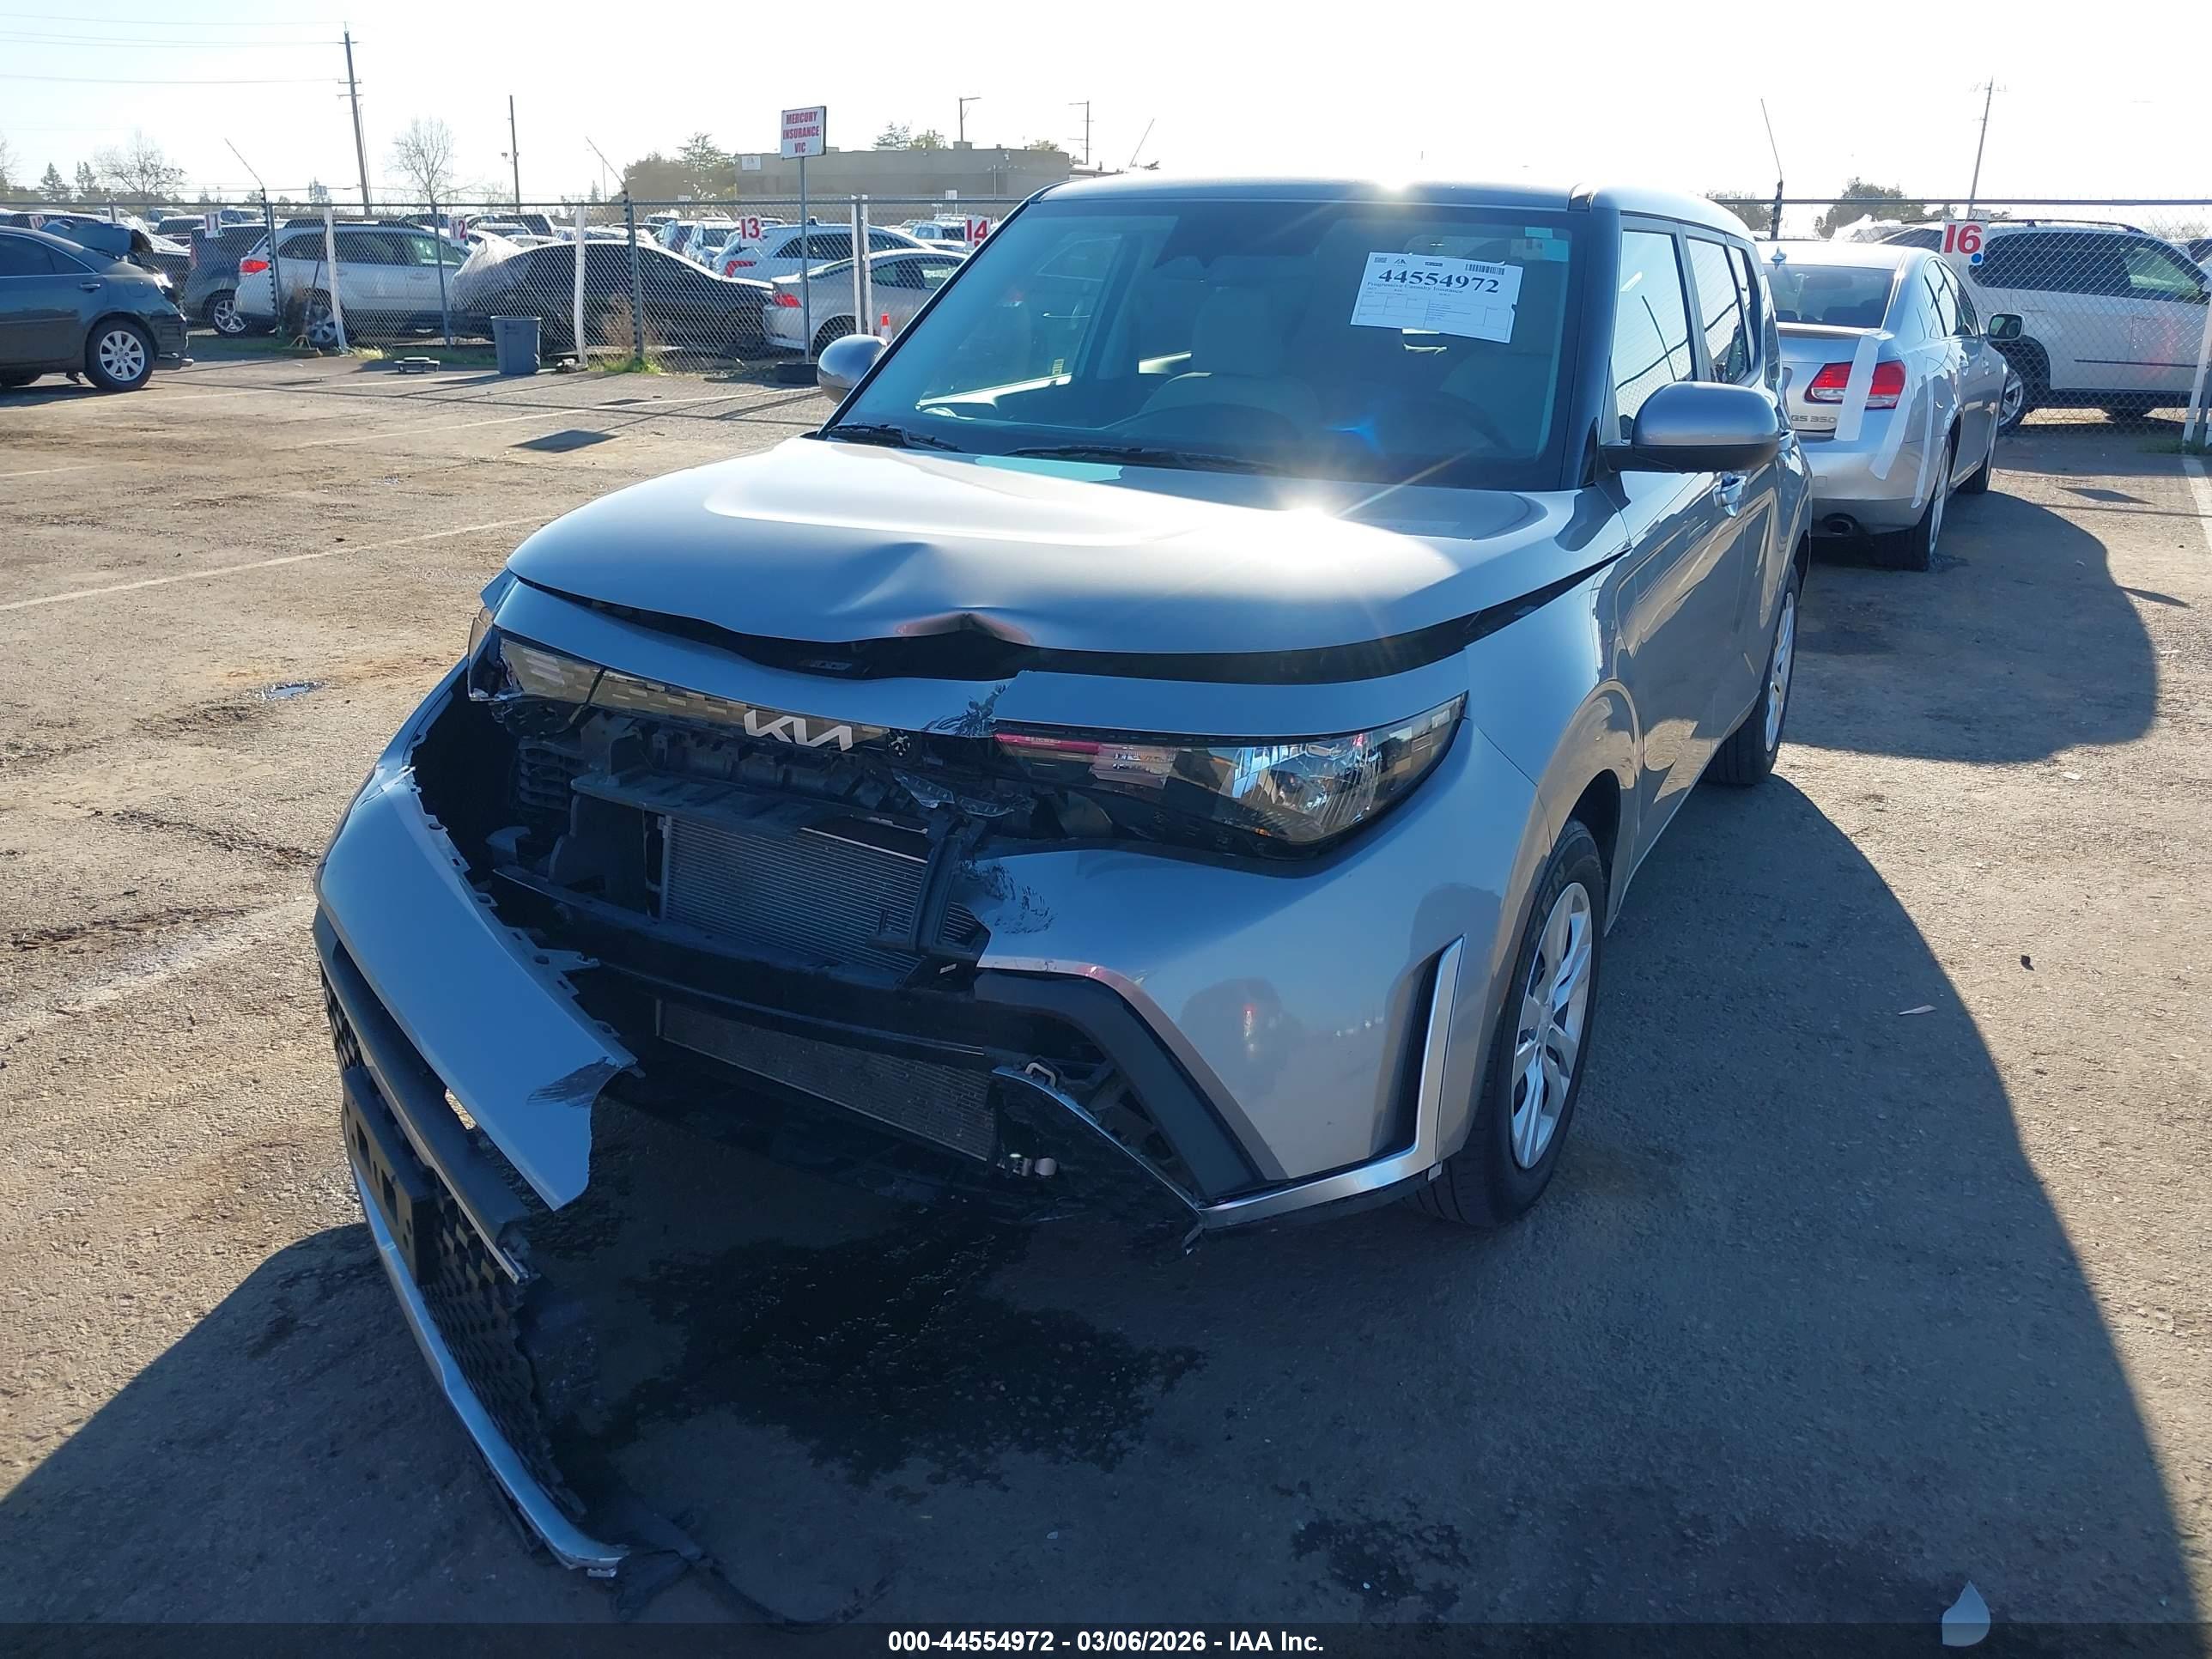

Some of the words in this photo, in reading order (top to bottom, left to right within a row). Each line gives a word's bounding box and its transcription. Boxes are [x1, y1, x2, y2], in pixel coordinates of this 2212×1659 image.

[786, 111, 818, 125] MERCURY
[782, 125, 820, 140] INSURANCE
[794, 142, 806, 154] VIC
[451, 219, 468, 240] 12
[740, 217, 761, 240] 13
[966, 219, 989, 242] 14
[1943, 224, 1983, 255] 16
[1378, 269, 1500, 294] 44554972
[744, 709, 854, 752] KIA
